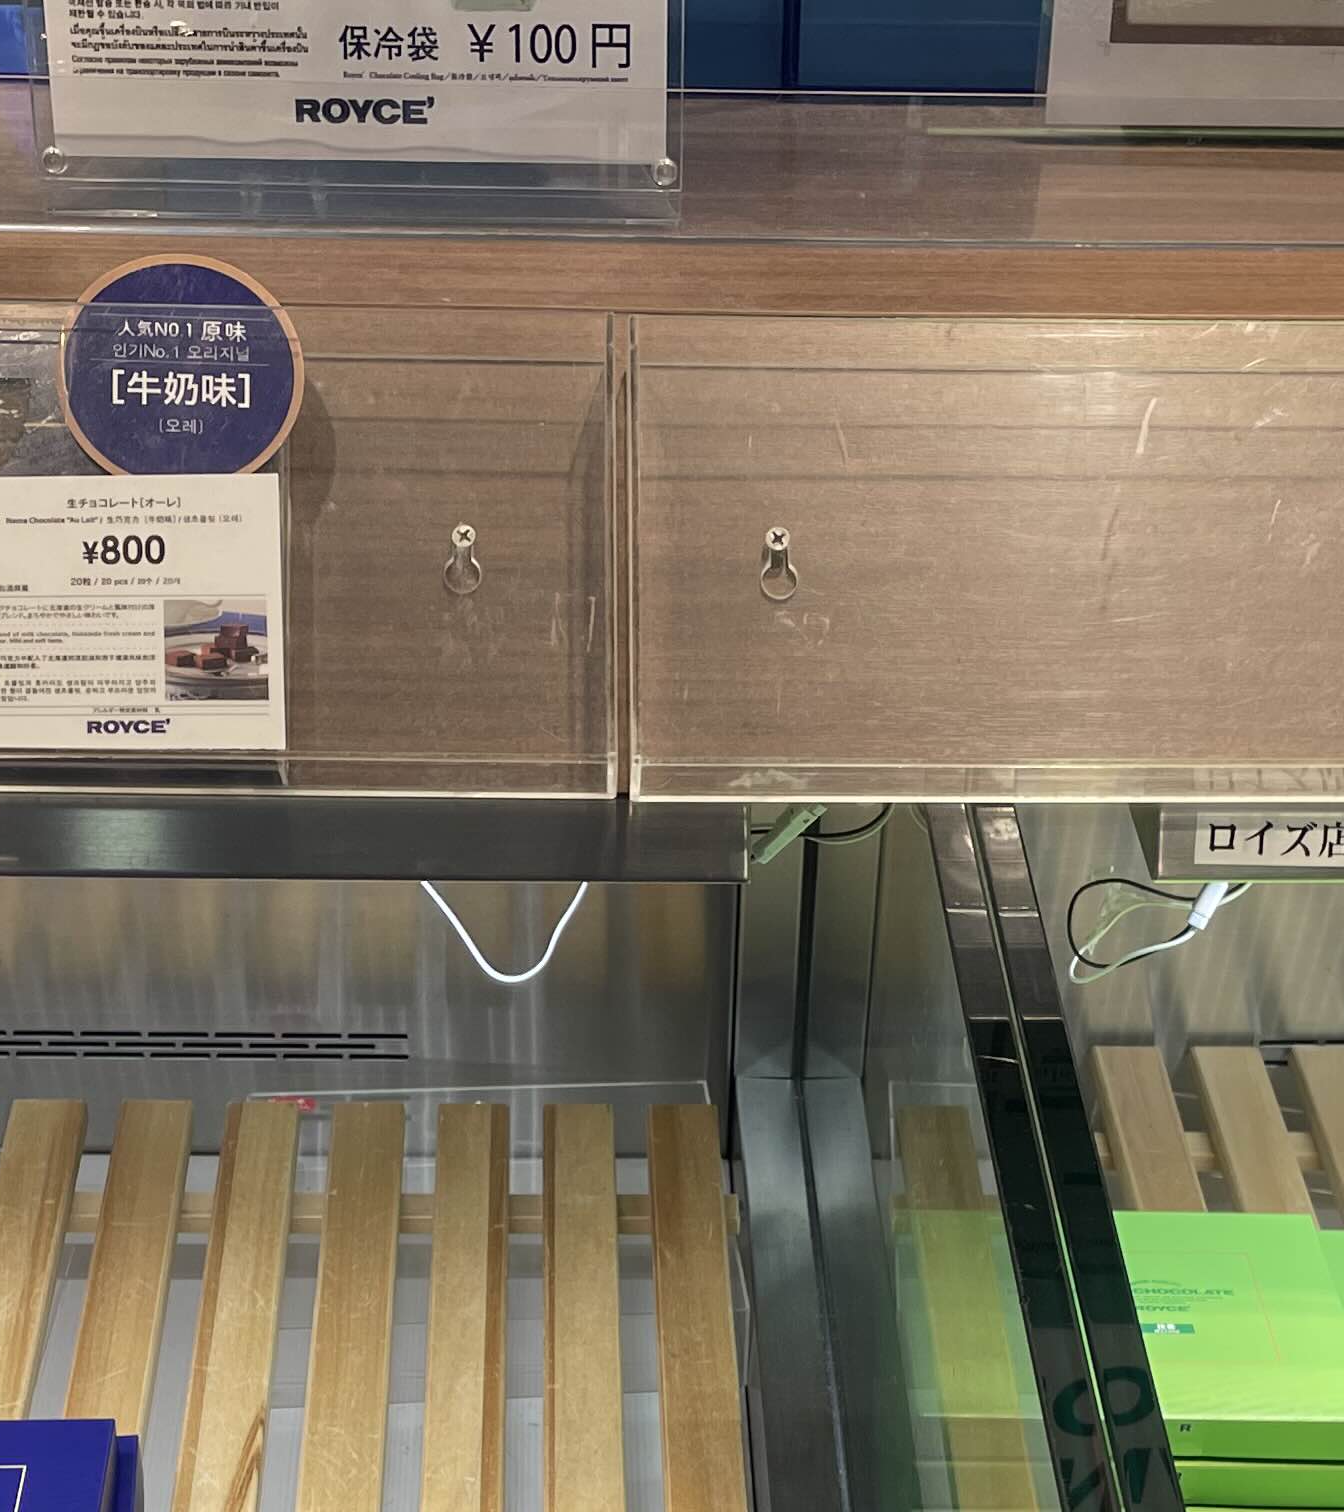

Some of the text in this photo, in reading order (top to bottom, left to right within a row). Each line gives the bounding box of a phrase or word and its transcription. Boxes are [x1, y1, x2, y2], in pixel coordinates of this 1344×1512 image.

[339, 25, 439, 61] 保冷袋
[294, 96, 435, 125] ROYCE'
[201, 320, 247, 342] 原味
[187, 345, 250, 362] 오리지널
[112, 368, 251, 409] [牛奶味]
[67, 497, 182, 508] 生チョコレート[オーレ]
[83, 535, 165, 565] ¥800
[114, 578, 128, 587] pcs
[87, 719, 170, 734] ROYCE'
